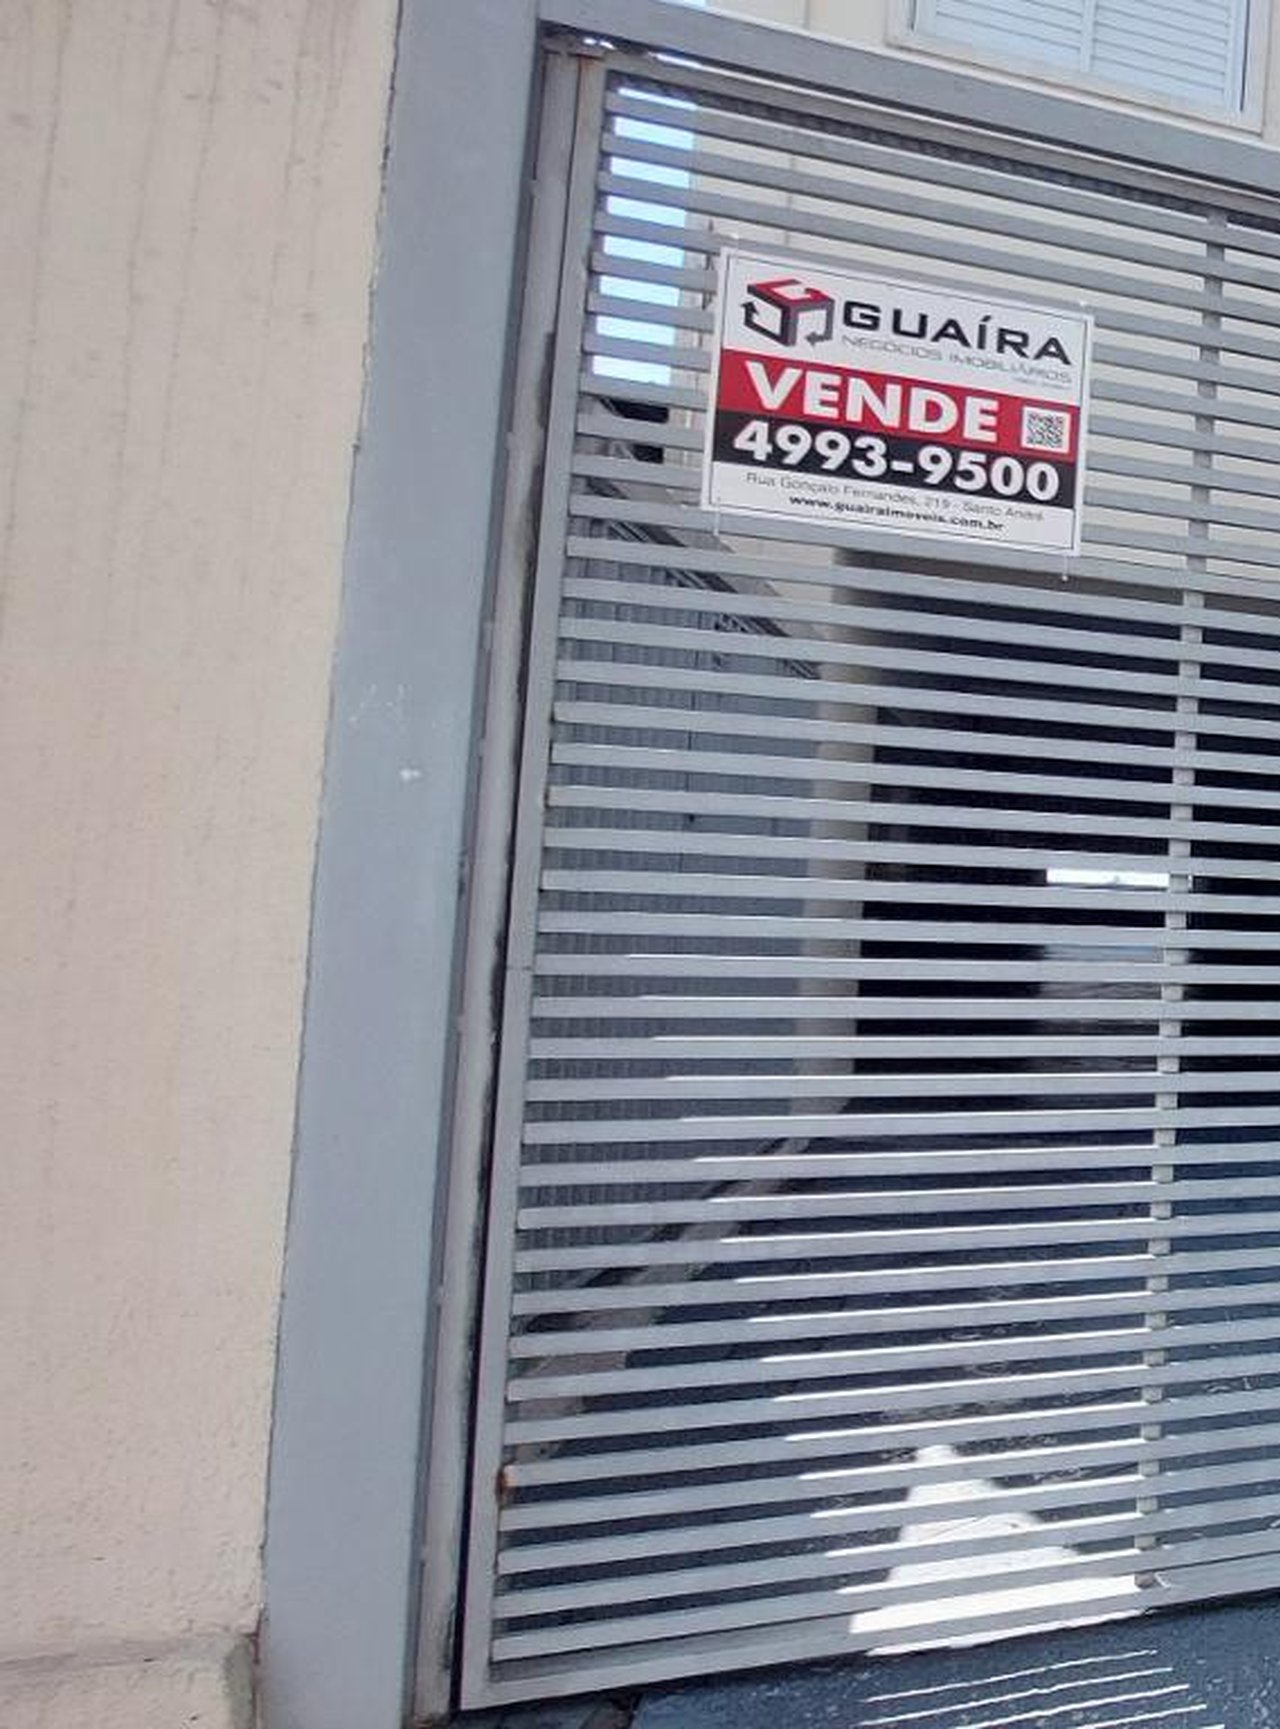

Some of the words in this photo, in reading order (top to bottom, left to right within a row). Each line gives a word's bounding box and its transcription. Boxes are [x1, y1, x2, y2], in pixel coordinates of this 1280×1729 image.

[842, 299, 1072, 365] GUAÍRA
[745, 360, 998, 442] VENDE
[733, 420, 1059, 500] 4993-9500
[747, 472, 775, 487] Rua
[963, 502, 1001, 516] Santo
